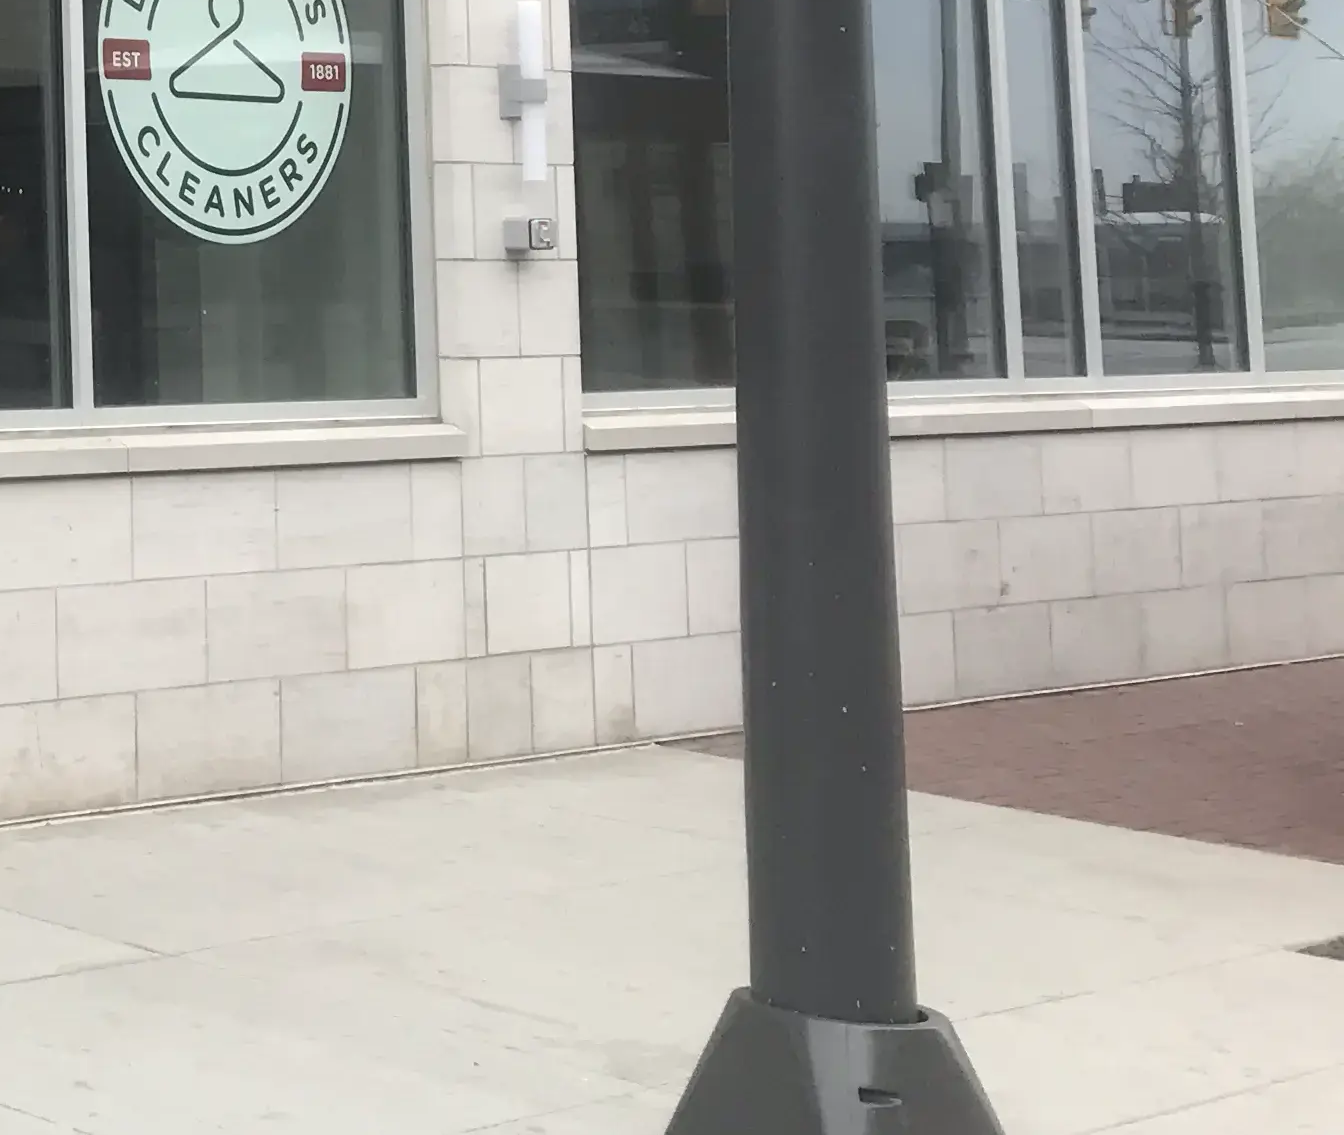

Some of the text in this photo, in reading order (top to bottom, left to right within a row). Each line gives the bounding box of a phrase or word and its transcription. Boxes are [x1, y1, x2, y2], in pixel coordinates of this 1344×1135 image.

[112, 51, 141, 68] EST
[309, 65, 339, 80] 1881
[137, 125, 318, 219] CLEANERS
